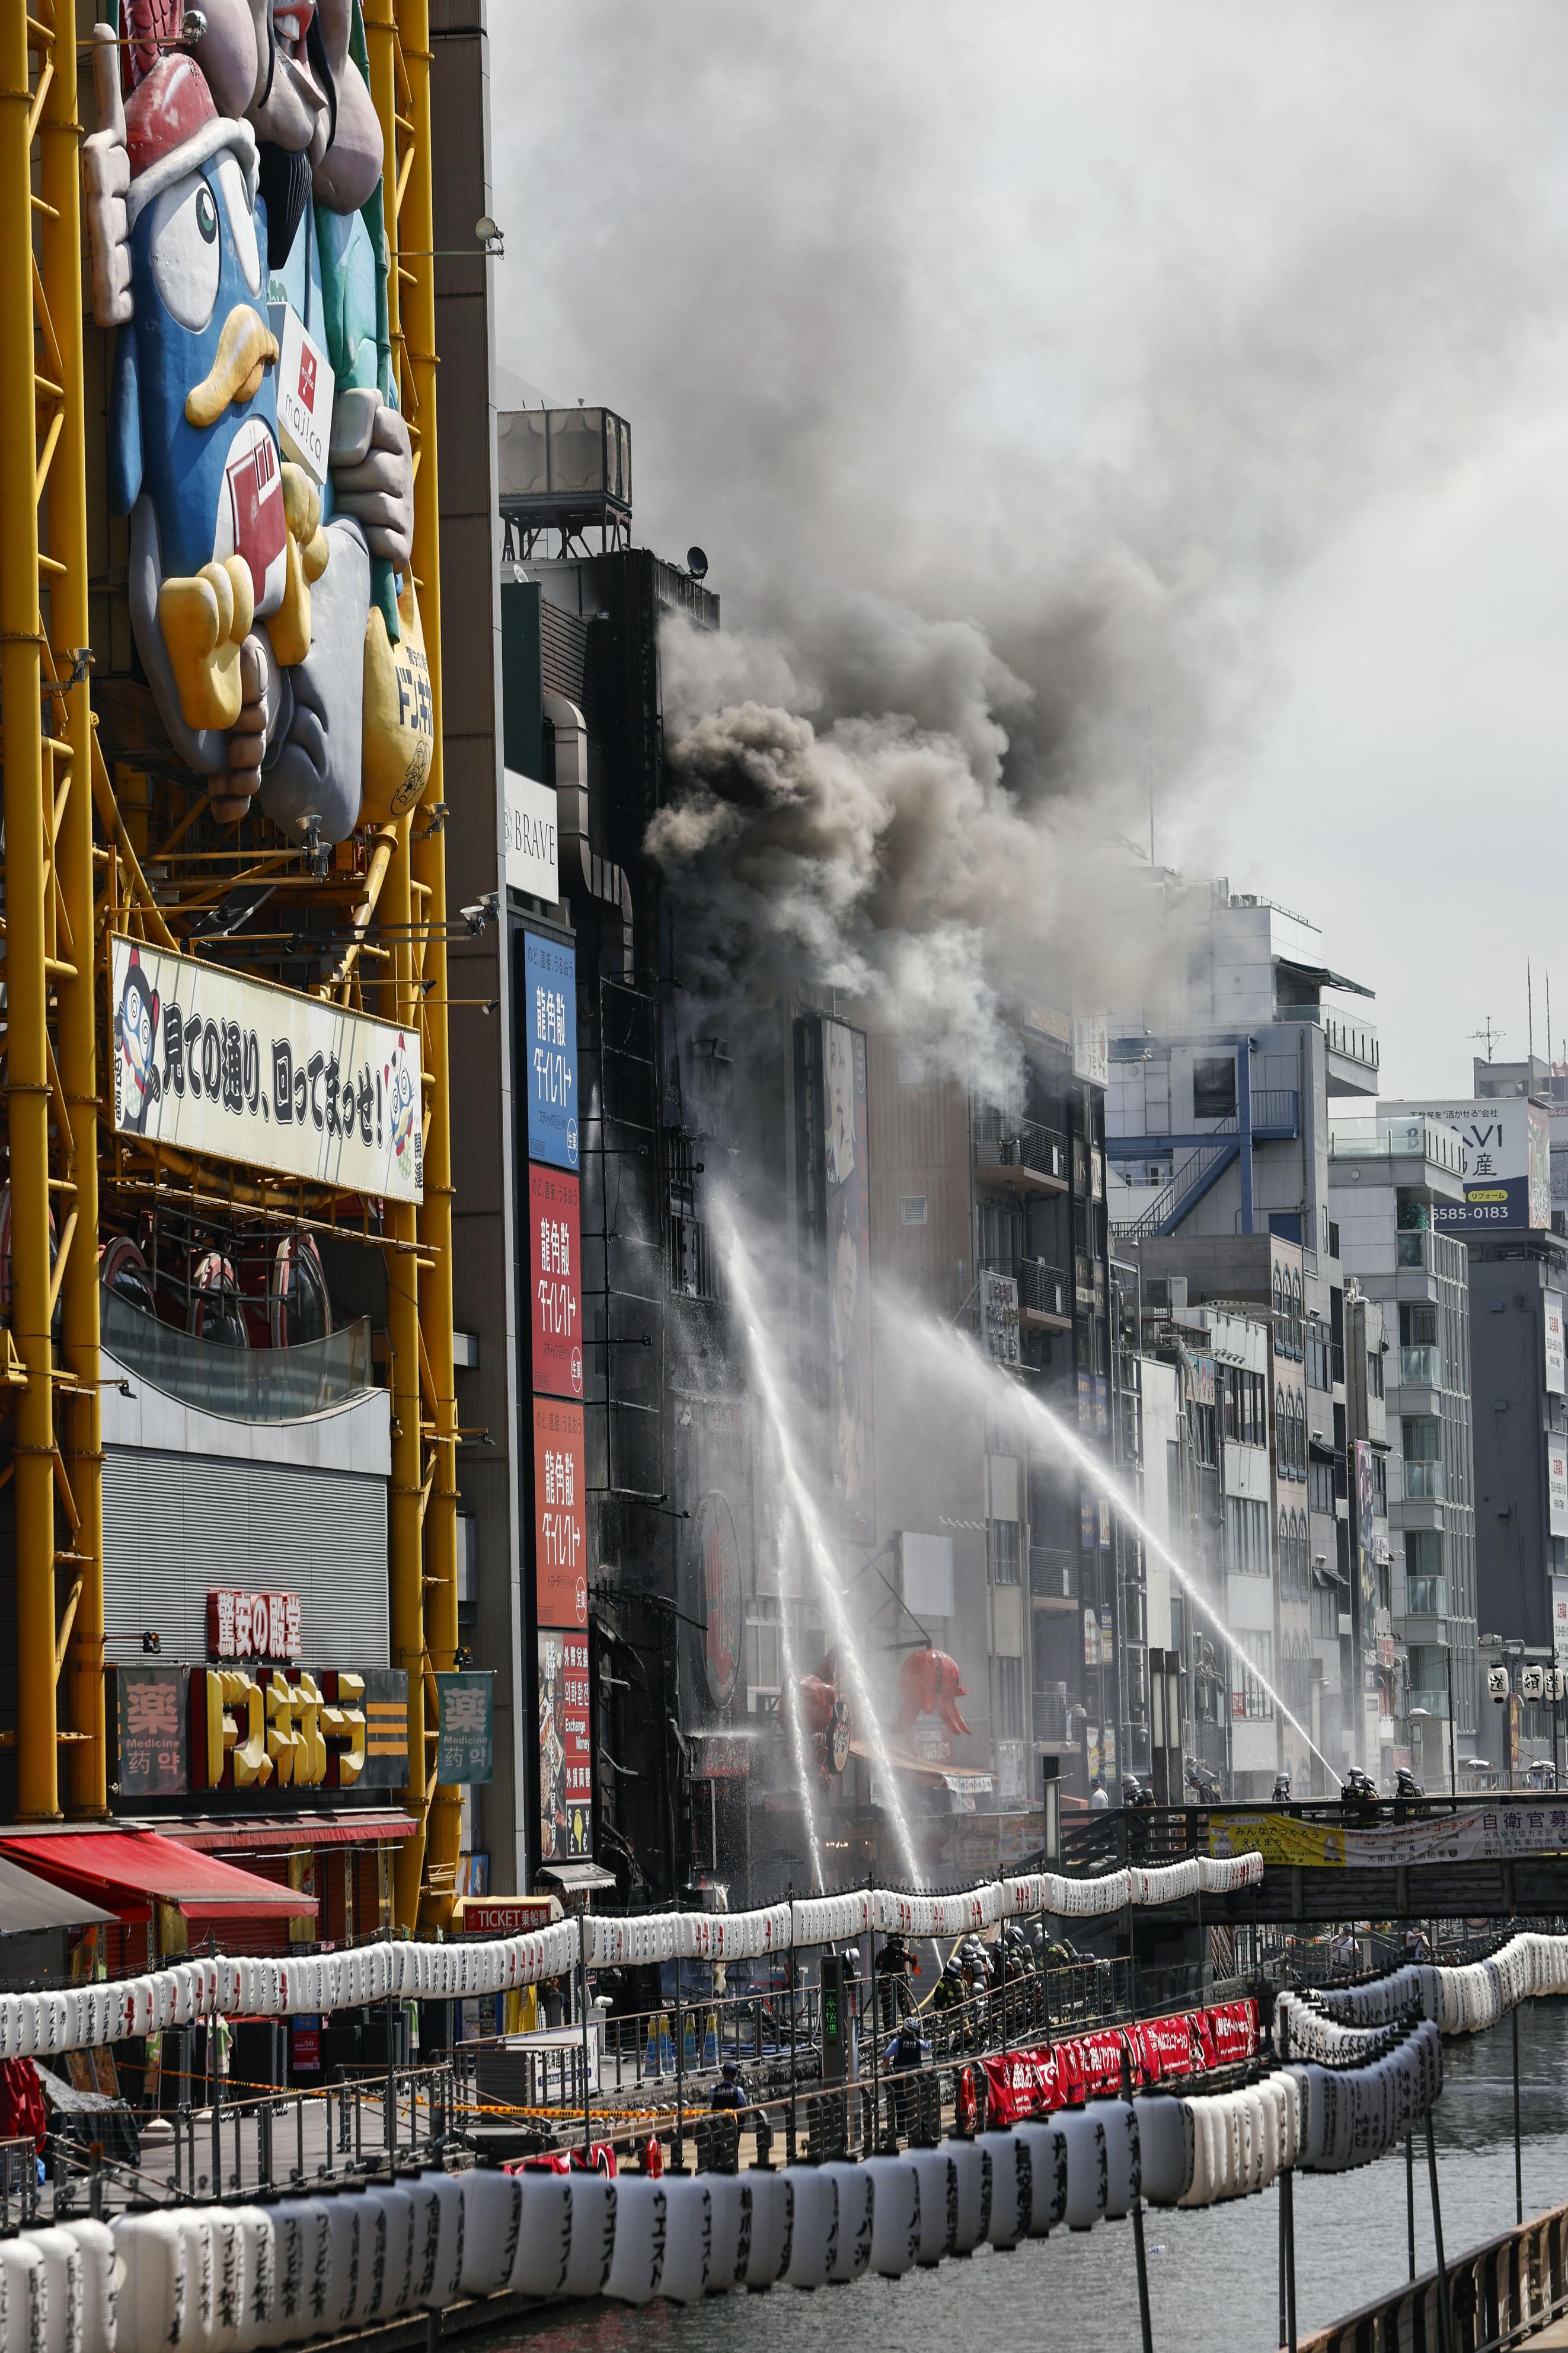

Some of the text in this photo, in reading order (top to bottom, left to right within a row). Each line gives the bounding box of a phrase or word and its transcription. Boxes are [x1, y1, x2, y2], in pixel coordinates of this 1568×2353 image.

[515, 809, 555, 865] BRAVE
[536, 986, 566, 1047] 龍角散
[534, 1047, 571, 1107] ダイレクト
[541, 1217, 570, 1277] 龍角散
[538, 1279, 576, 1337] ダイレクト
[545, 1449, 574, 1507] 龍角散
[542, 1512, 580, 1567] ダイレクト
[218, 1590, 302, 1658] 驚安の殿堂
[564, 1681, 589, 1706] 외화환전
[1490, 1675, 1506, 1692] 道
[126, 1683, 178, 1735] 薬
[443, 1688, 487, 1733] 薬
[566, 1717, 586, 1735] Exchange
[126, 1739, 180, 1748] Medicine
[443, 1736, 487, 1745] Medicine
[576, 1736, 590, 1752] Money
[127, 1751, 151, 1775] 药
[158, 1752, 180, 1775] 약
[445, 1746, 464, 1768] 药
[469, 1747, 487, 1767] 약
[566, 1767, 590, 1788] 外貨両替
[1235, 1826, 1320, 1839] みんなでつくろう
[1484, 1829, 1553, 1839] 大阪地方協力本部
[1484, 1838, 1553, 1848] 谷九募集案内所
[1368, 1850, 1445, 1862] 大阪市中央消防署
[478, 1909, 520, 1927] TICKET
